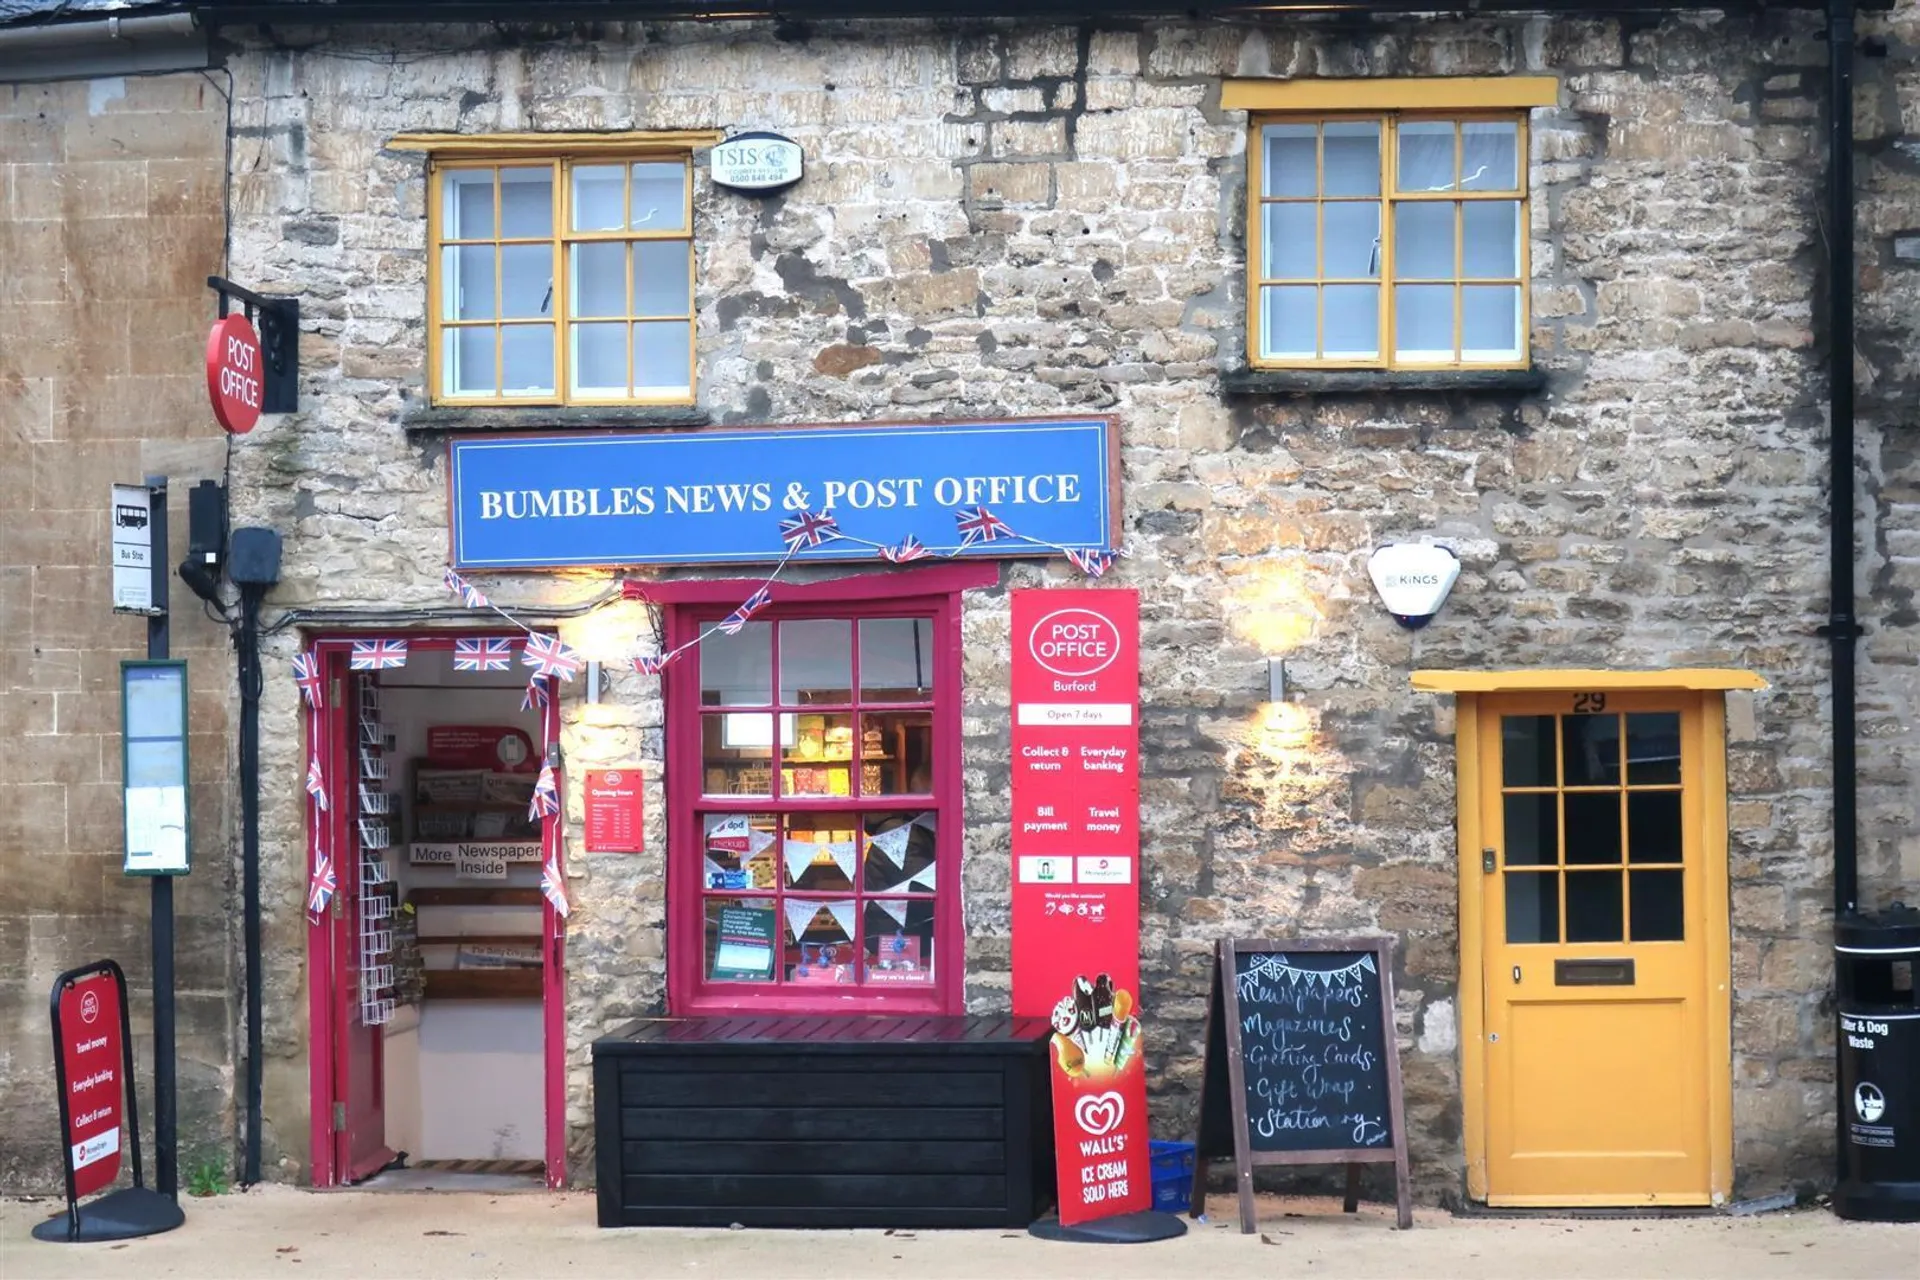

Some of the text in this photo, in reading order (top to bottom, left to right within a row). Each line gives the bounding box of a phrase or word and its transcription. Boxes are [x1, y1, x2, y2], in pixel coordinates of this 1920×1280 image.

[719, 148, 757, 166] ISIS
[228, 335, 255, 372] POST
[221, 366, 258, 408] OFFICE
[480, 474, 1081, 519] BUMBLES NEWS & POST OFFICE
[121, 549, 144, 561] Bus Stop
[1052, 624, 1100, 640] POST
[1040, 642, 1107, 658] OFFICE
[1053, 681, 1097, 692] Burford
[1573, 691, 1605, 713] 29
[1047, 709, 1103, 721] Open 7 days
[1022, 746, 1059, 757] Collect
[1080, 746, 1127, 759] Everyday
[1030, 761, 1061, 771] return
[1083, 760, 1124, 773] banking
[592, 789, 617, 797] Opening
[1037, 806, 1054, 817] Bill
[1088, 807, 1120, 818] Travel
[728, 820, 744, 830] dpd
[1023, 822, 1068, 833] payment
[1086, 823, 1122, 834] money
[415, 848, 452, 861] More
[461, 860, 504, 874] Inside
[872, 973, 887, 982] Sorry
[906, 973, 924, 981] closed
[1241, 981, 1362, 1015] Newspapers
[1243, 1012, 1351, 1051] Magazines
[1858, 1020, 1865, 1033] &
[1867, 1020, 1888, 1036] Dog
[76, 1036, 107, 1054] Travel money
[1848, 1035, 1874, 1049] Waste
[1250, 1043, 1373, 1084] Greeting Cards
[72, 1070, 113, 1093] Everyday banking
[1257, 1077, 1354, 1106] Gift Wrap
[75, 1114, 93, 1128] Collect
[97, 1106, 112, 1118] return
[1080, 1135, 1124, 1157] WALL'S
[1081, 1160, 1127, 1184] ICE CREAM
[1083, 1180, 1129, 1204] SOLD HERE
